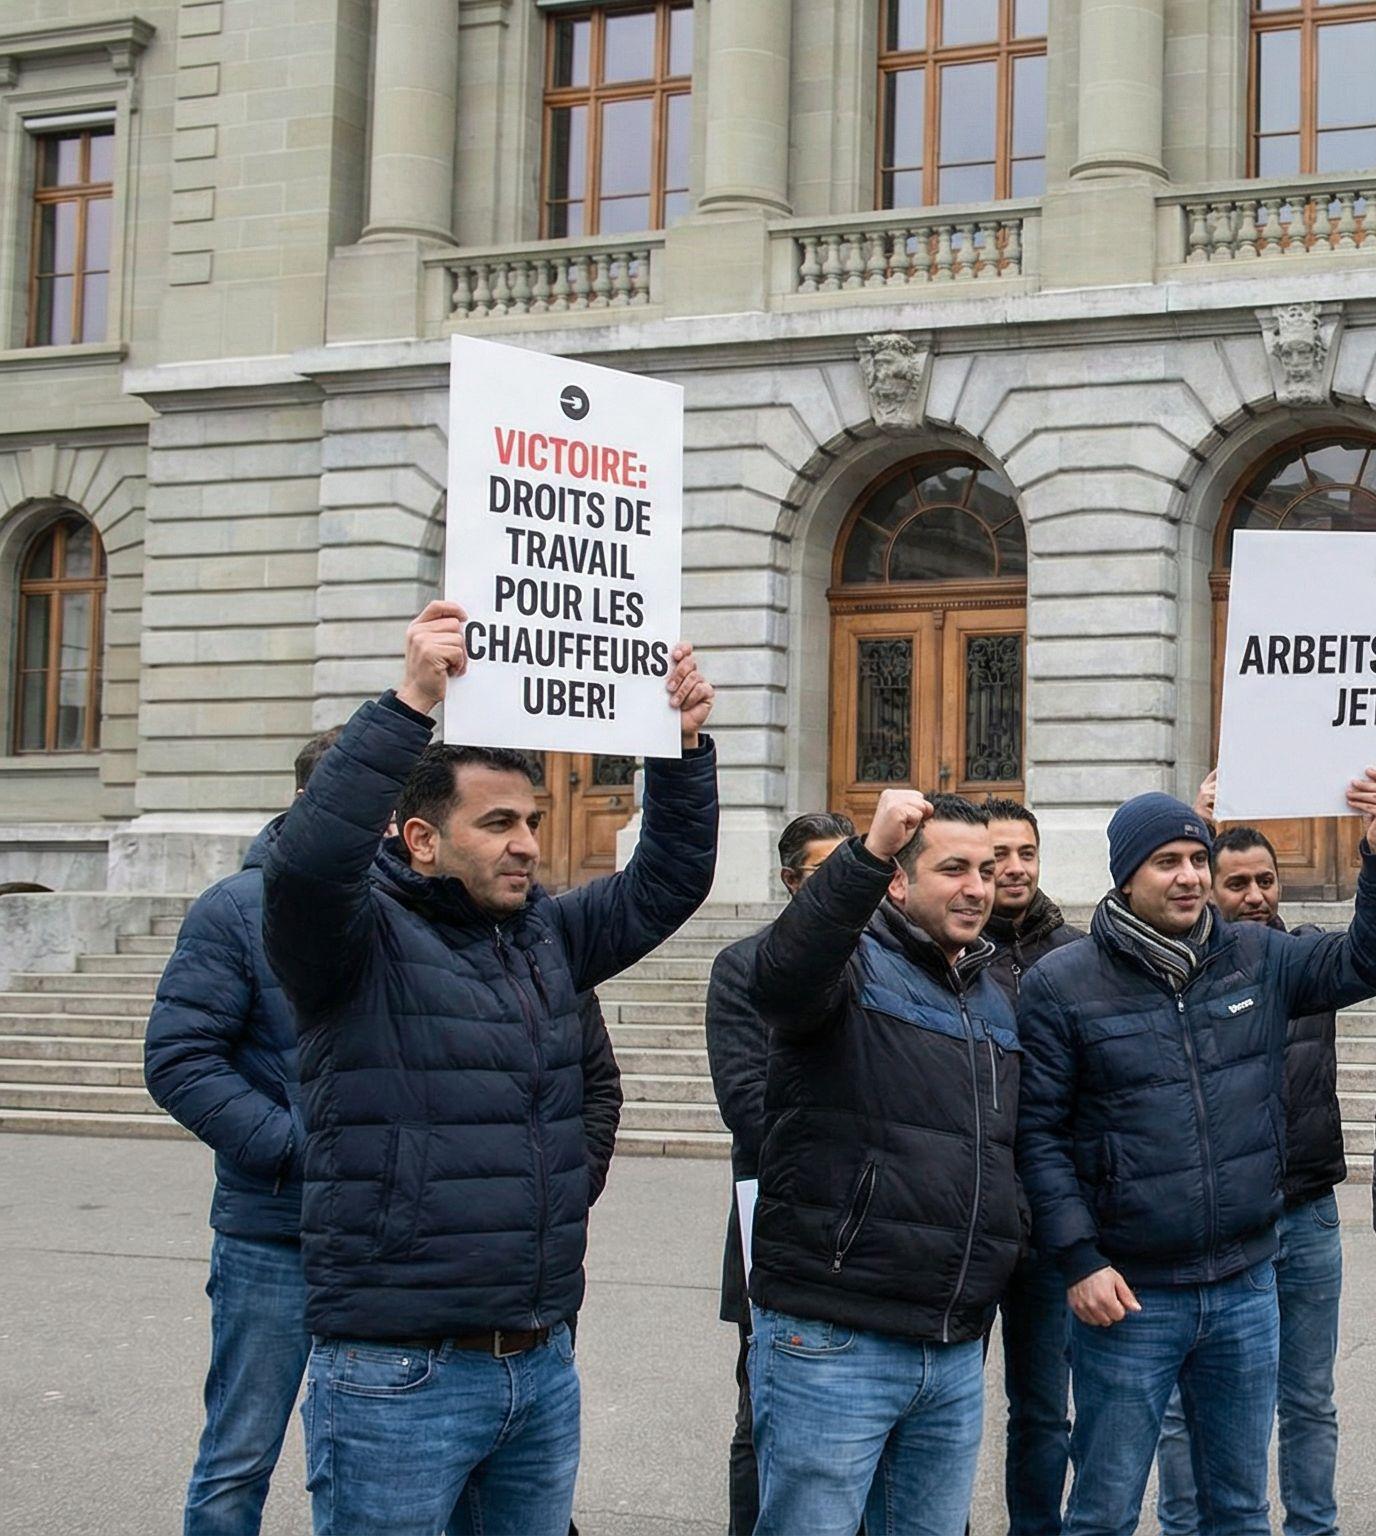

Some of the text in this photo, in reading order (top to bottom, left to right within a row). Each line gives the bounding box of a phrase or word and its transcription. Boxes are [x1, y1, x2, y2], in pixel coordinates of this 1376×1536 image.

[494, 427, 648, 489] VICTOIRE:
[489, 475, 652, 537] DROITS DE
[505, 526, 635, 581] TRAVAIL
[495, 575, 644, 629] POUR LES
[464, 621, 669, 677] CHAUFFEURS
[523, 676, 615, 720] UBER!
